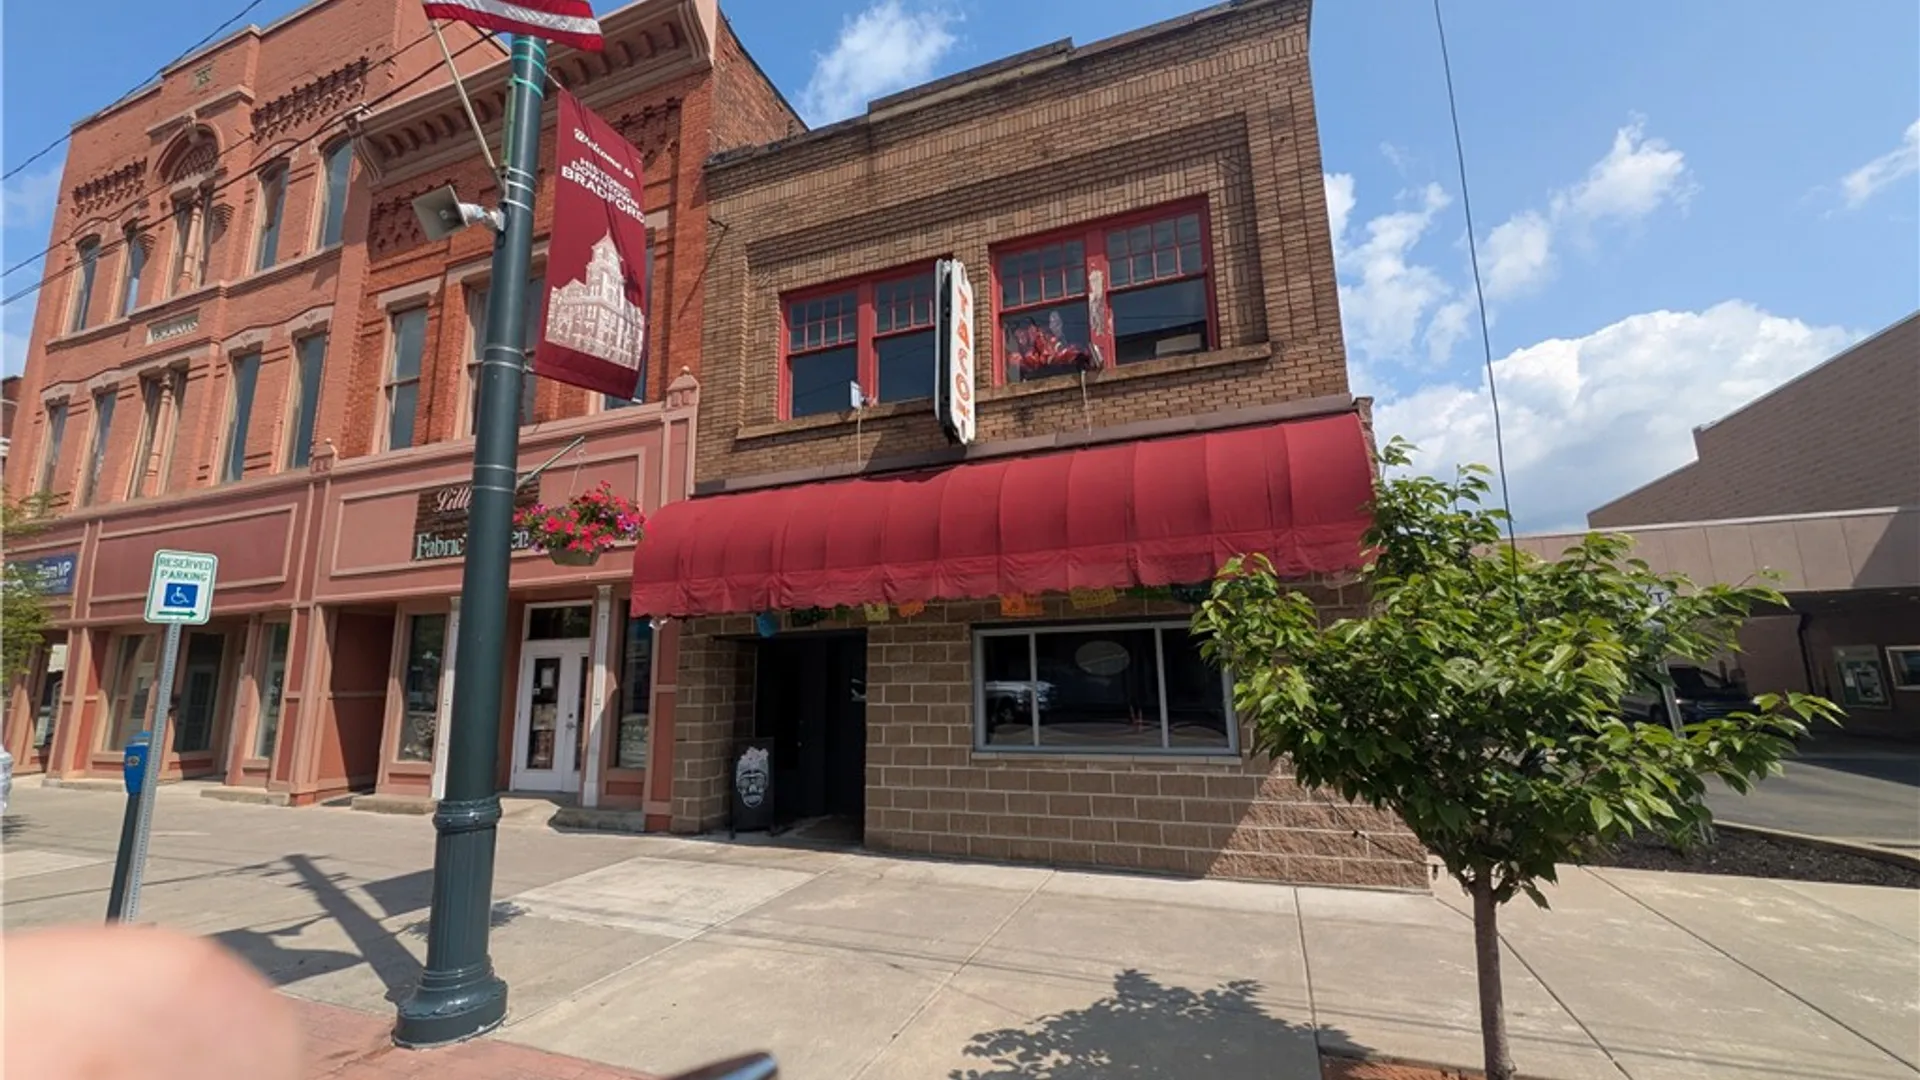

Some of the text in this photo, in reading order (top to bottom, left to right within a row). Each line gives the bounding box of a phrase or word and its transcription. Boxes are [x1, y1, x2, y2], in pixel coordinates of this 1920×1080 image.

[574, 128, 635, 179] Welcome to
[561, 165, 645, 223] BRADFORD
[571, 160, 639, 208] DOWNTOWN
[580, 157, 631, 196] HISTORIC
[159, 556, 211, 570] RESERVED
[415, 532, 464, 560] Fabric
[160, 570, 208, 581] PARKING
